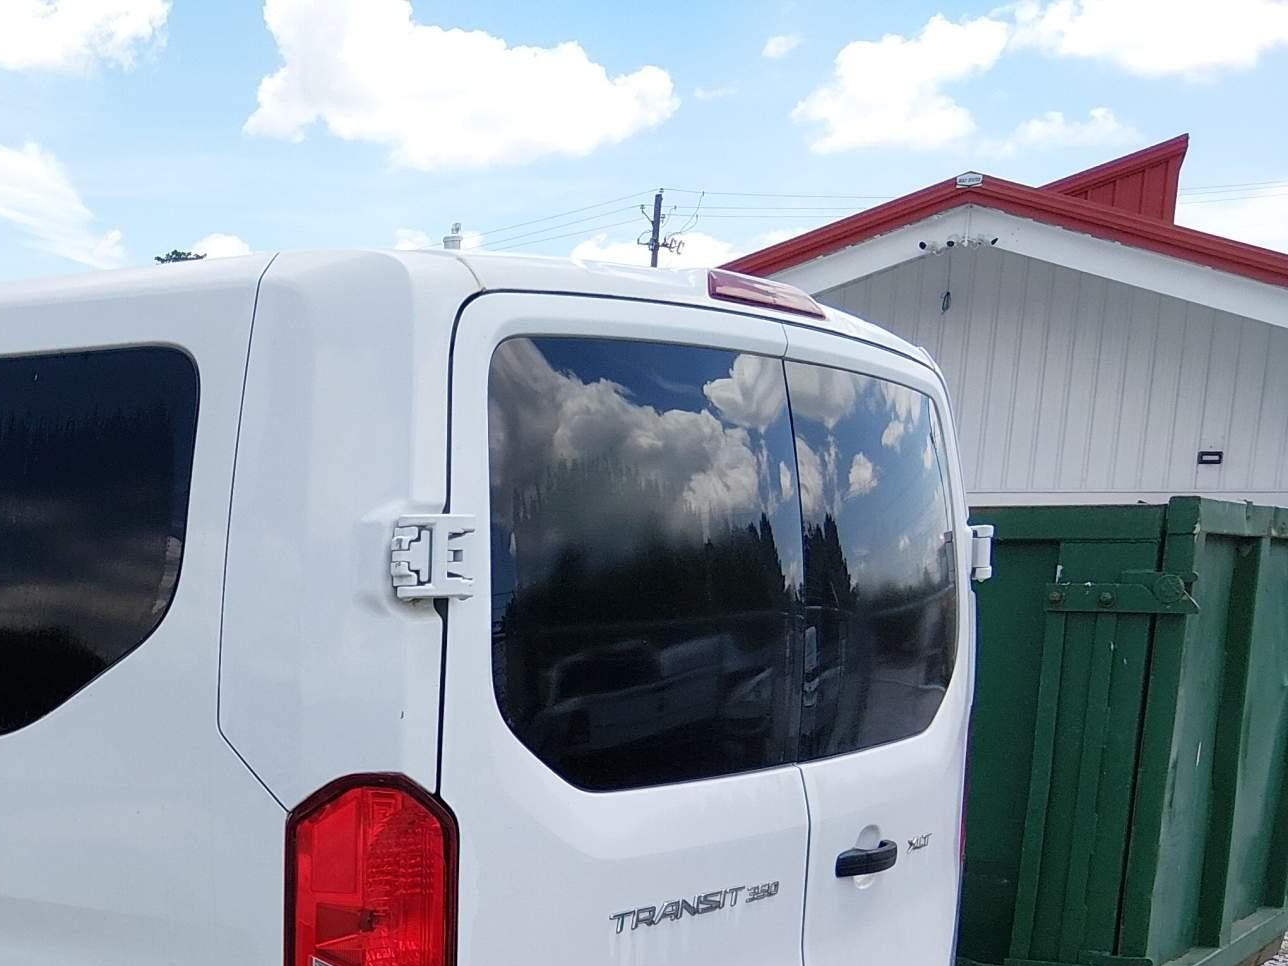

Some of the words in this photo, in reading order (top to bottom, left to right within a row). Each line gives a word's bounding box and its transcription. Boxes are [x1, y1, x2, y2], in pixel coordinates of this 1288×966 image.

[907, 833, 933, 853] XLT
[609, 885, 745, 934] TRANSIT
[746, 881, 780, 903] 350
